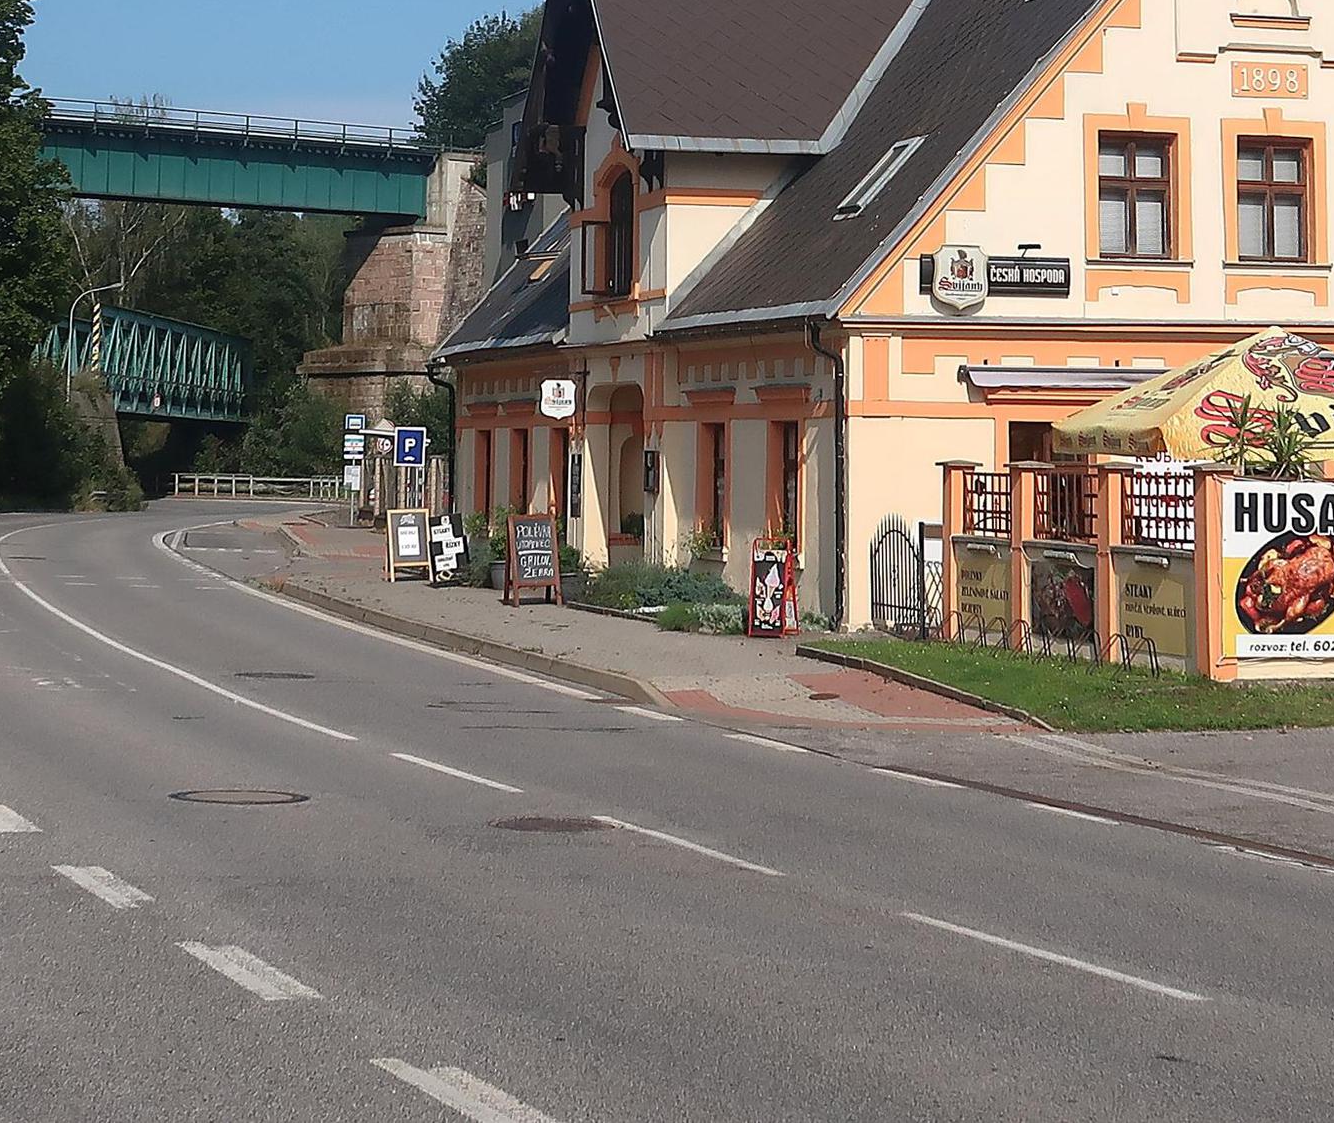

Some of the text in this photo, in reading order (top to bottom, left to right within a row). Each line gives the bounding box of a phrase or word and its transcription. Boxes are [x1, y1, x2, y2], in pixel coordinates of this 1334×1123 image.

[1241, 67, 1299, 93] 1898
[990, 265, 1065, 284] ČESKÁ HOSPODA
[938, 276, 983, 292] Svijany
[404, 438, 416, 452] P
[1249, 643, 1287, 652] rozvoz:
[1290, 641, 1309, 652] tel.
